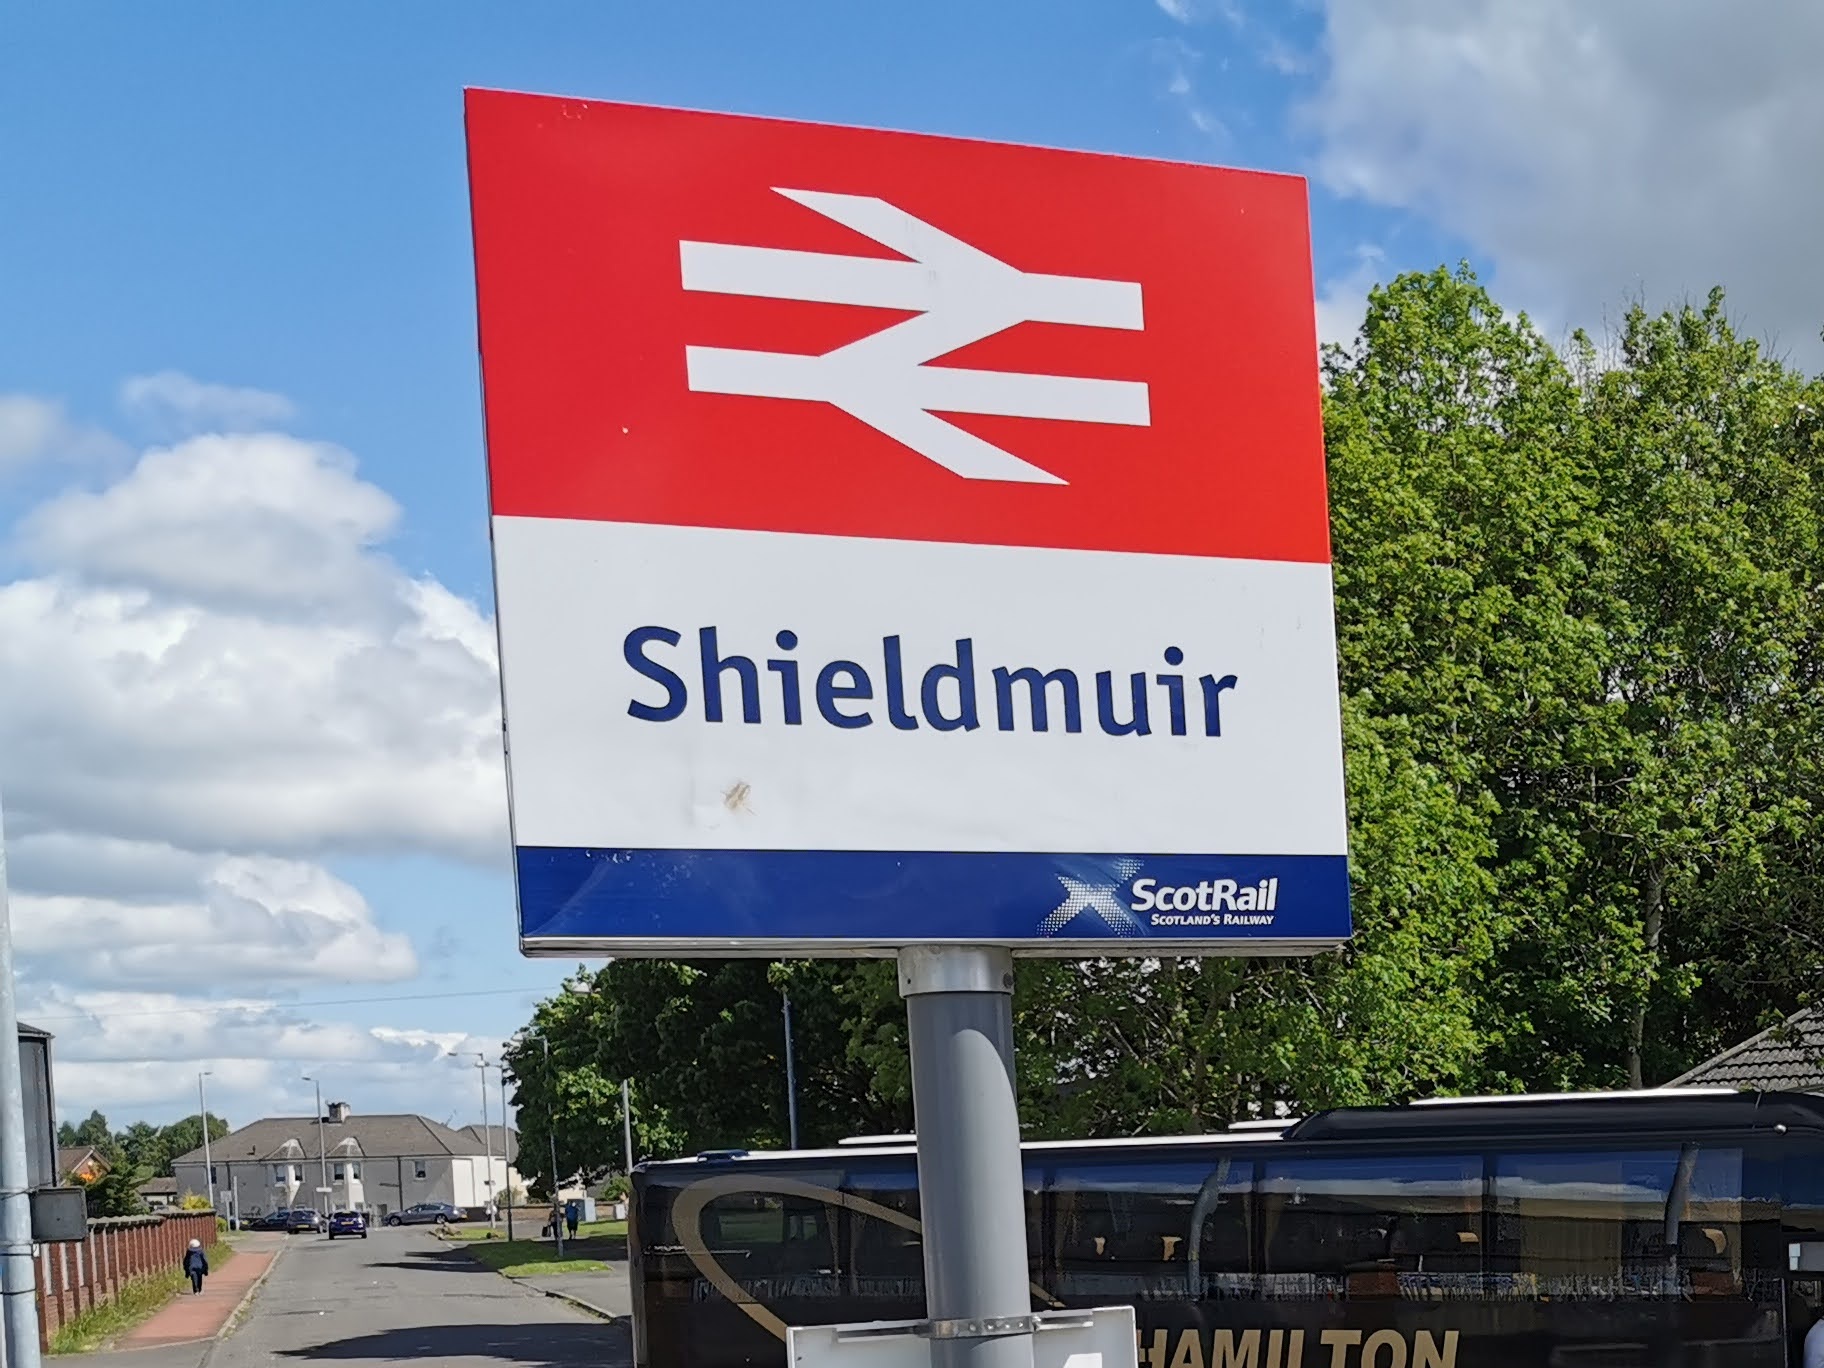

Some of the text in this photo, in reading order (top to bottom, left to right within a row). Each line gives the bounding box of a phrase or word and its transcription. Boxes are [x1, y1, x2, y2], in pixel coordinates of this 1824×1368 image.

[623, 625, 1239, 738] Shieldmuir
[1130, 877, 1279, 912] ScotRail
[1150, 913, 1275, 926] SCOTLAND'S RAILWAY
